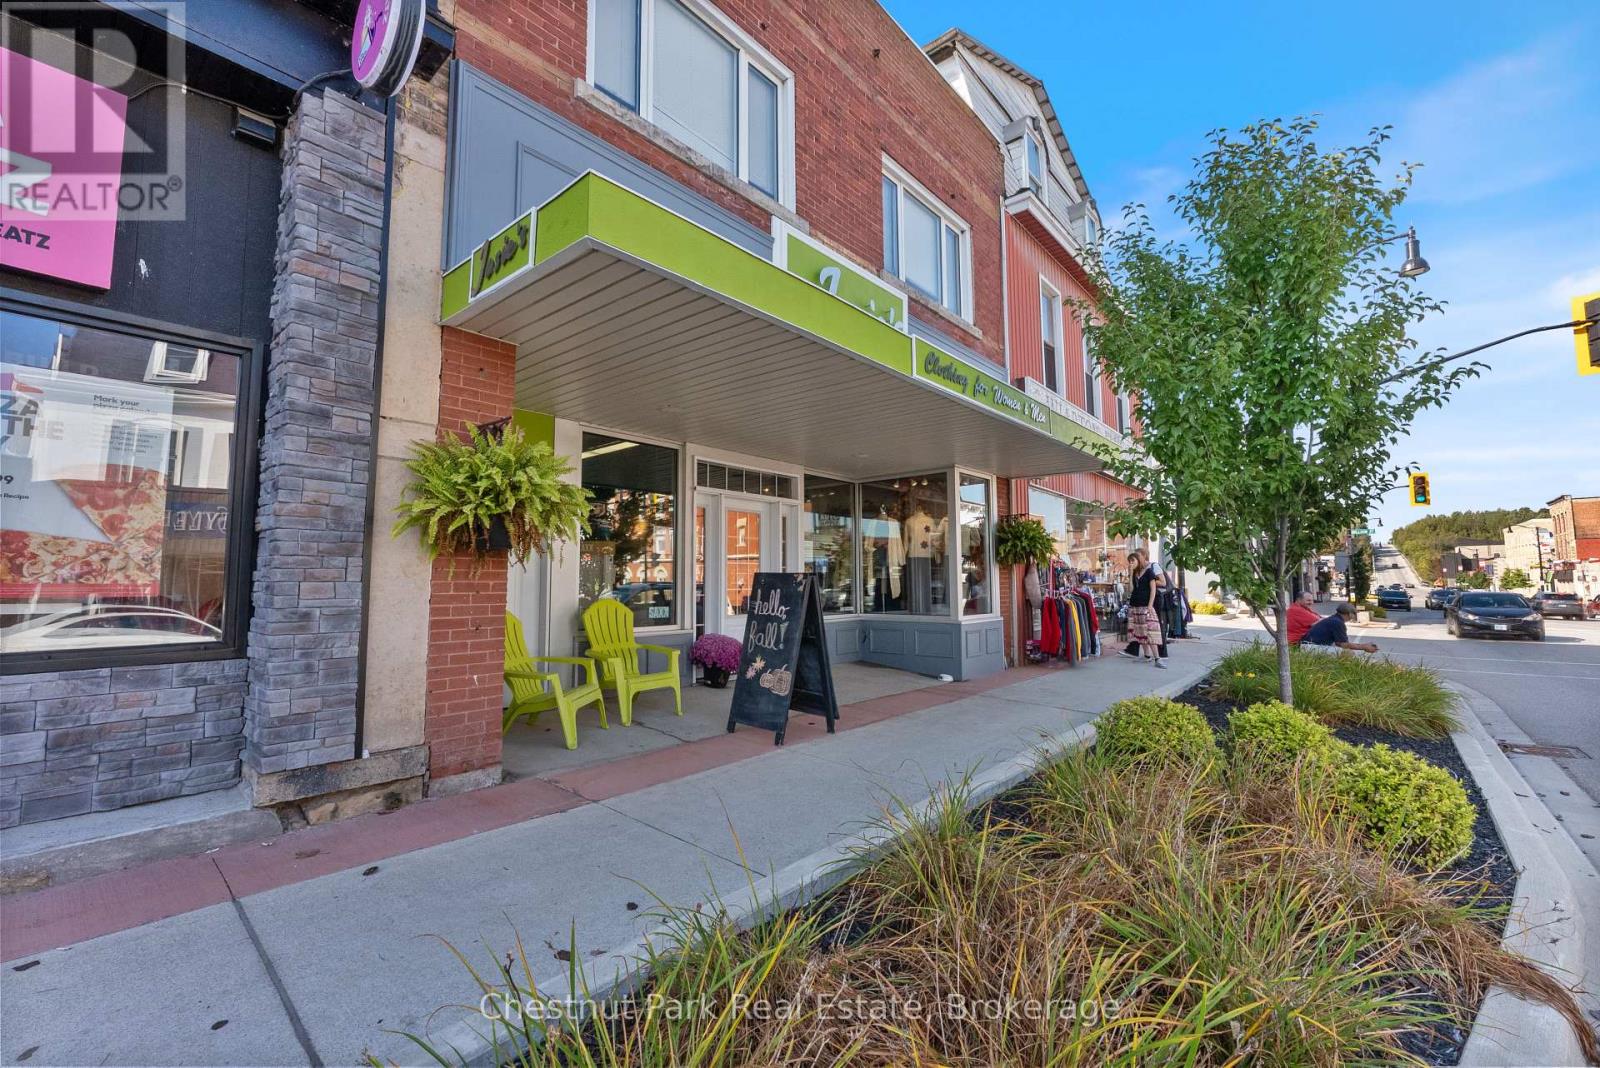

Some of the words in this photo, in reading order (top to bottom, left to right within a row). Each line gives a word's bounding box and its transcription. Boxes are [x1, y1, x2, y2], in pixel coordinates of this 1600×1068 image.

[924, 351, 968, 394] Clothing
[973, 375, 988, 398] for
[93, 394, 119, 403] Mark
[120, 399, 141, 407] your
[748, 621, 790, 653] fall!
